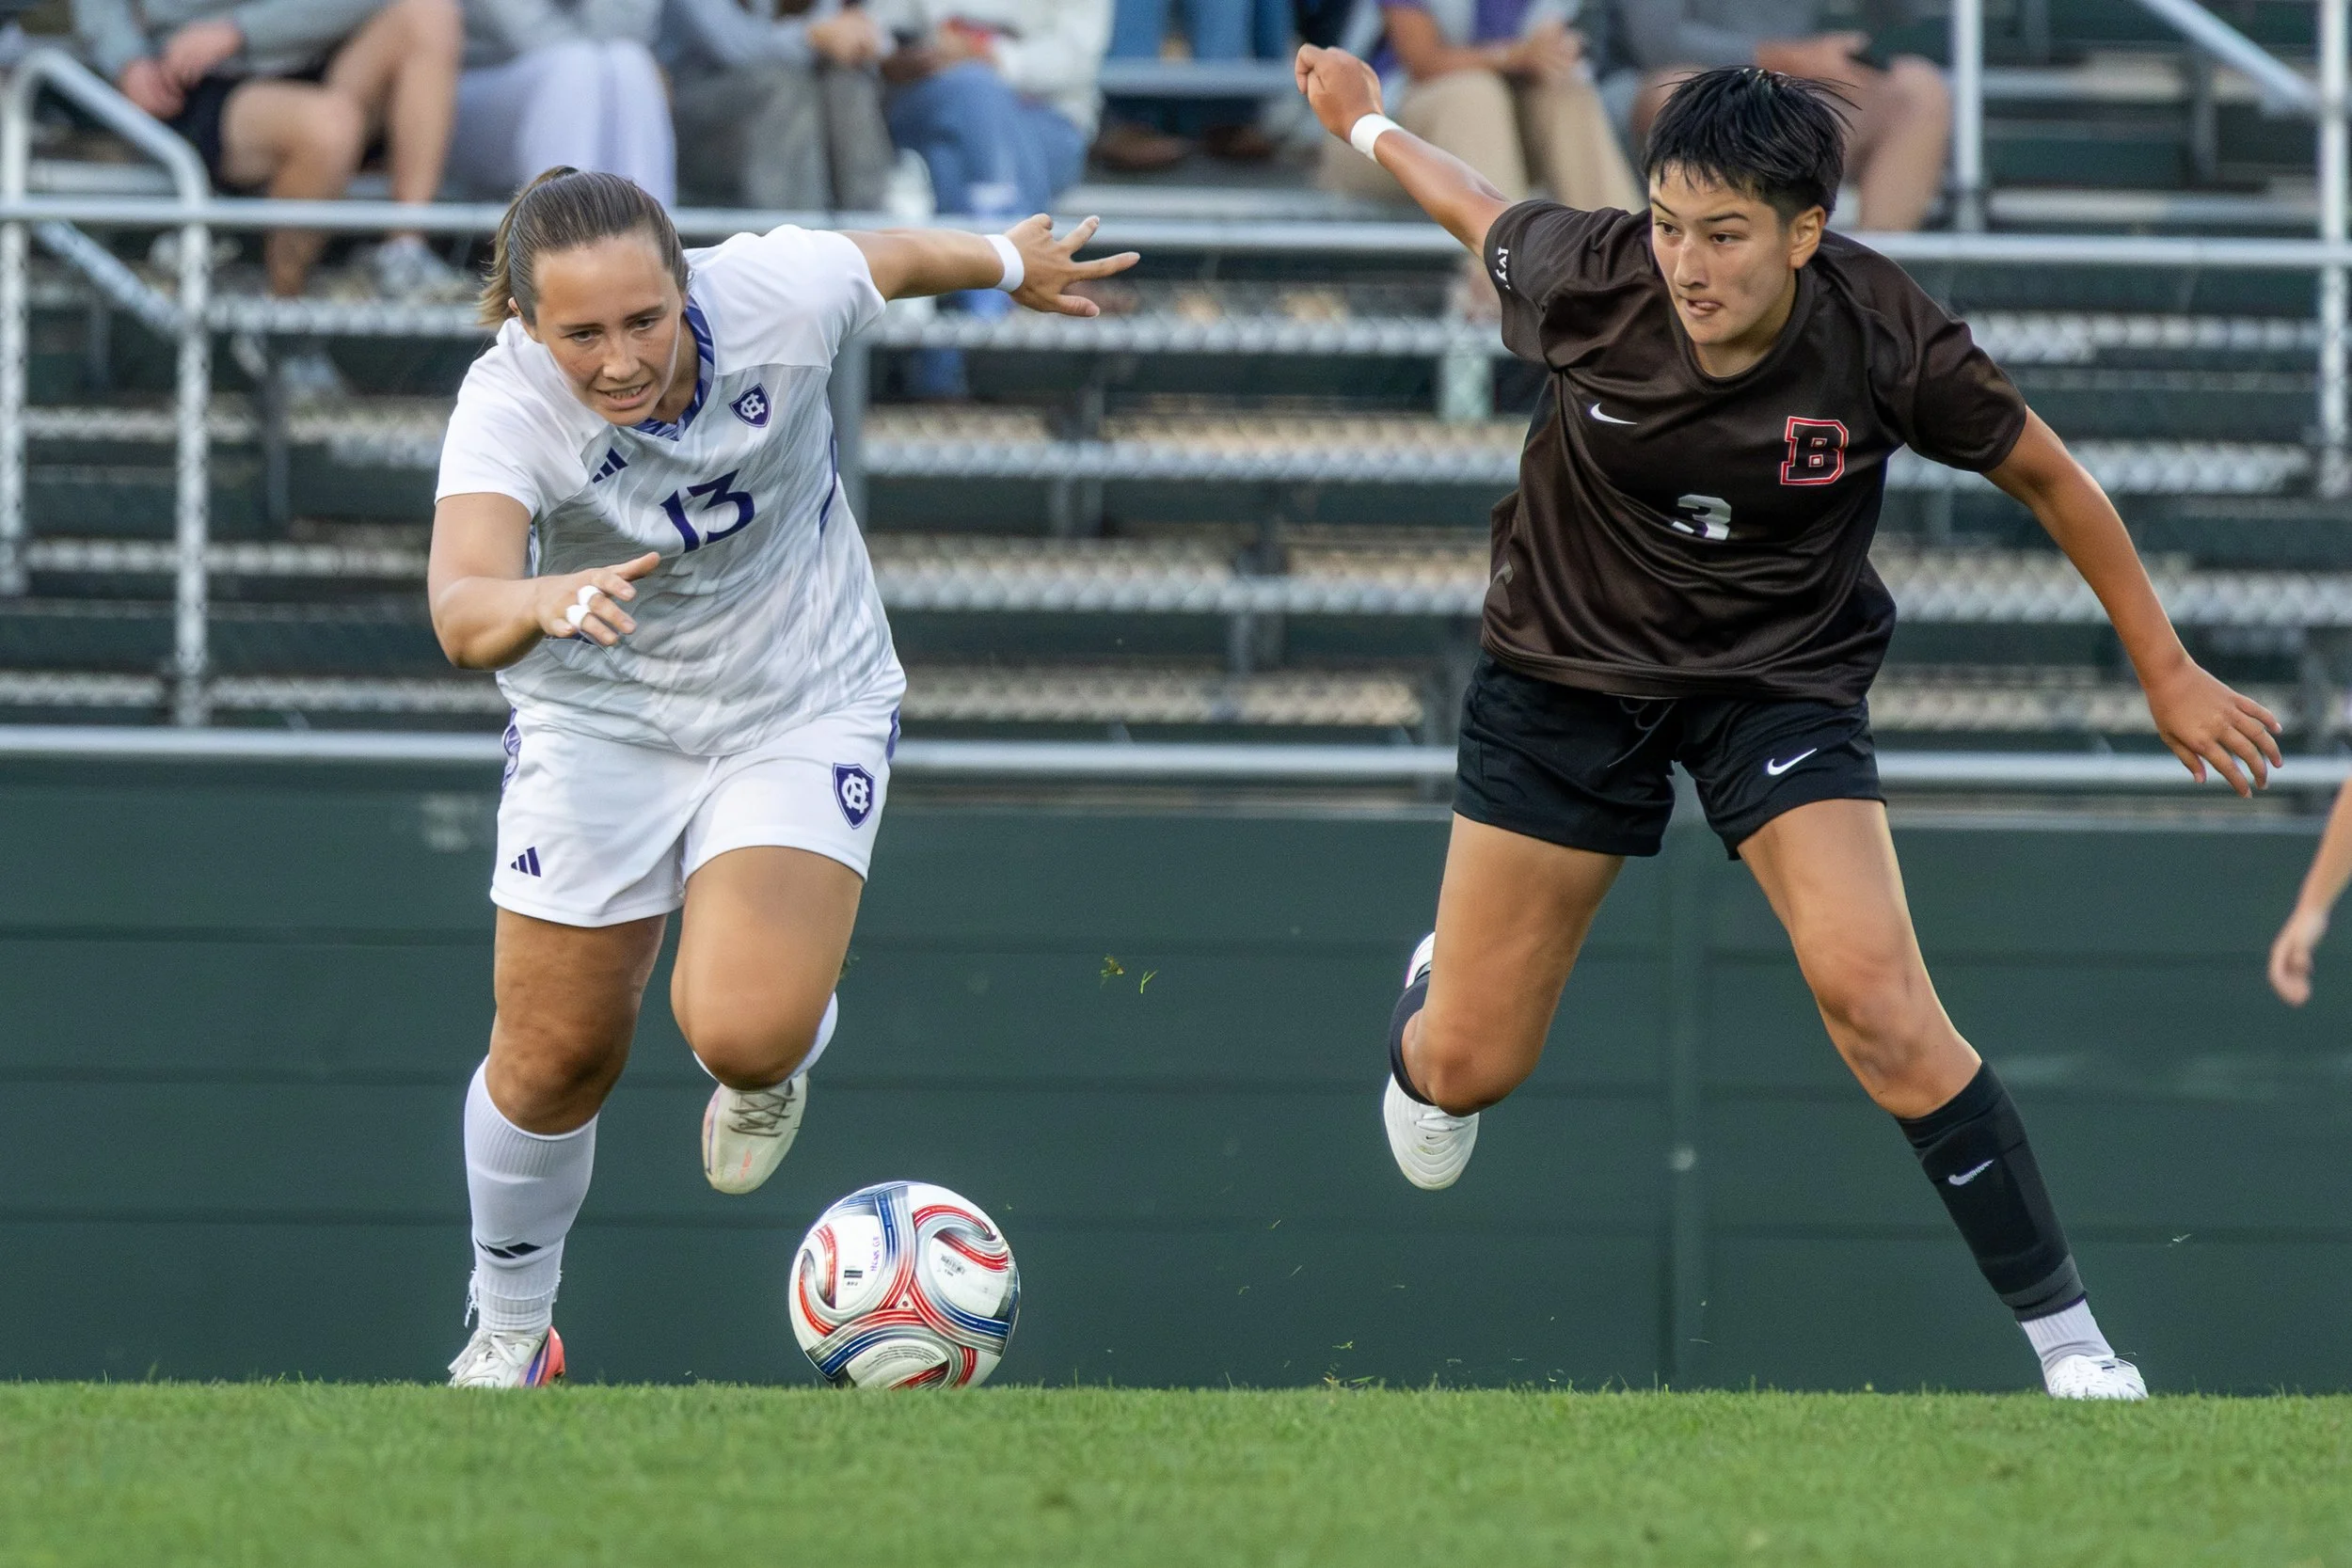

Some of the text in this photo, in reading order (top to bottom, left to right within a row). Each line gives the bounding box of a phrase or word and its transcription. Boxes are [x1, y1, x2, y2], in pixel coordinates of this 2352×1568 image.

[1495, 246, 1509, 281] IVY
[1780, 416, 1850, 485] B
[660, 468, 755, 553] 13
[1672, 494, 1732, 541] 3
